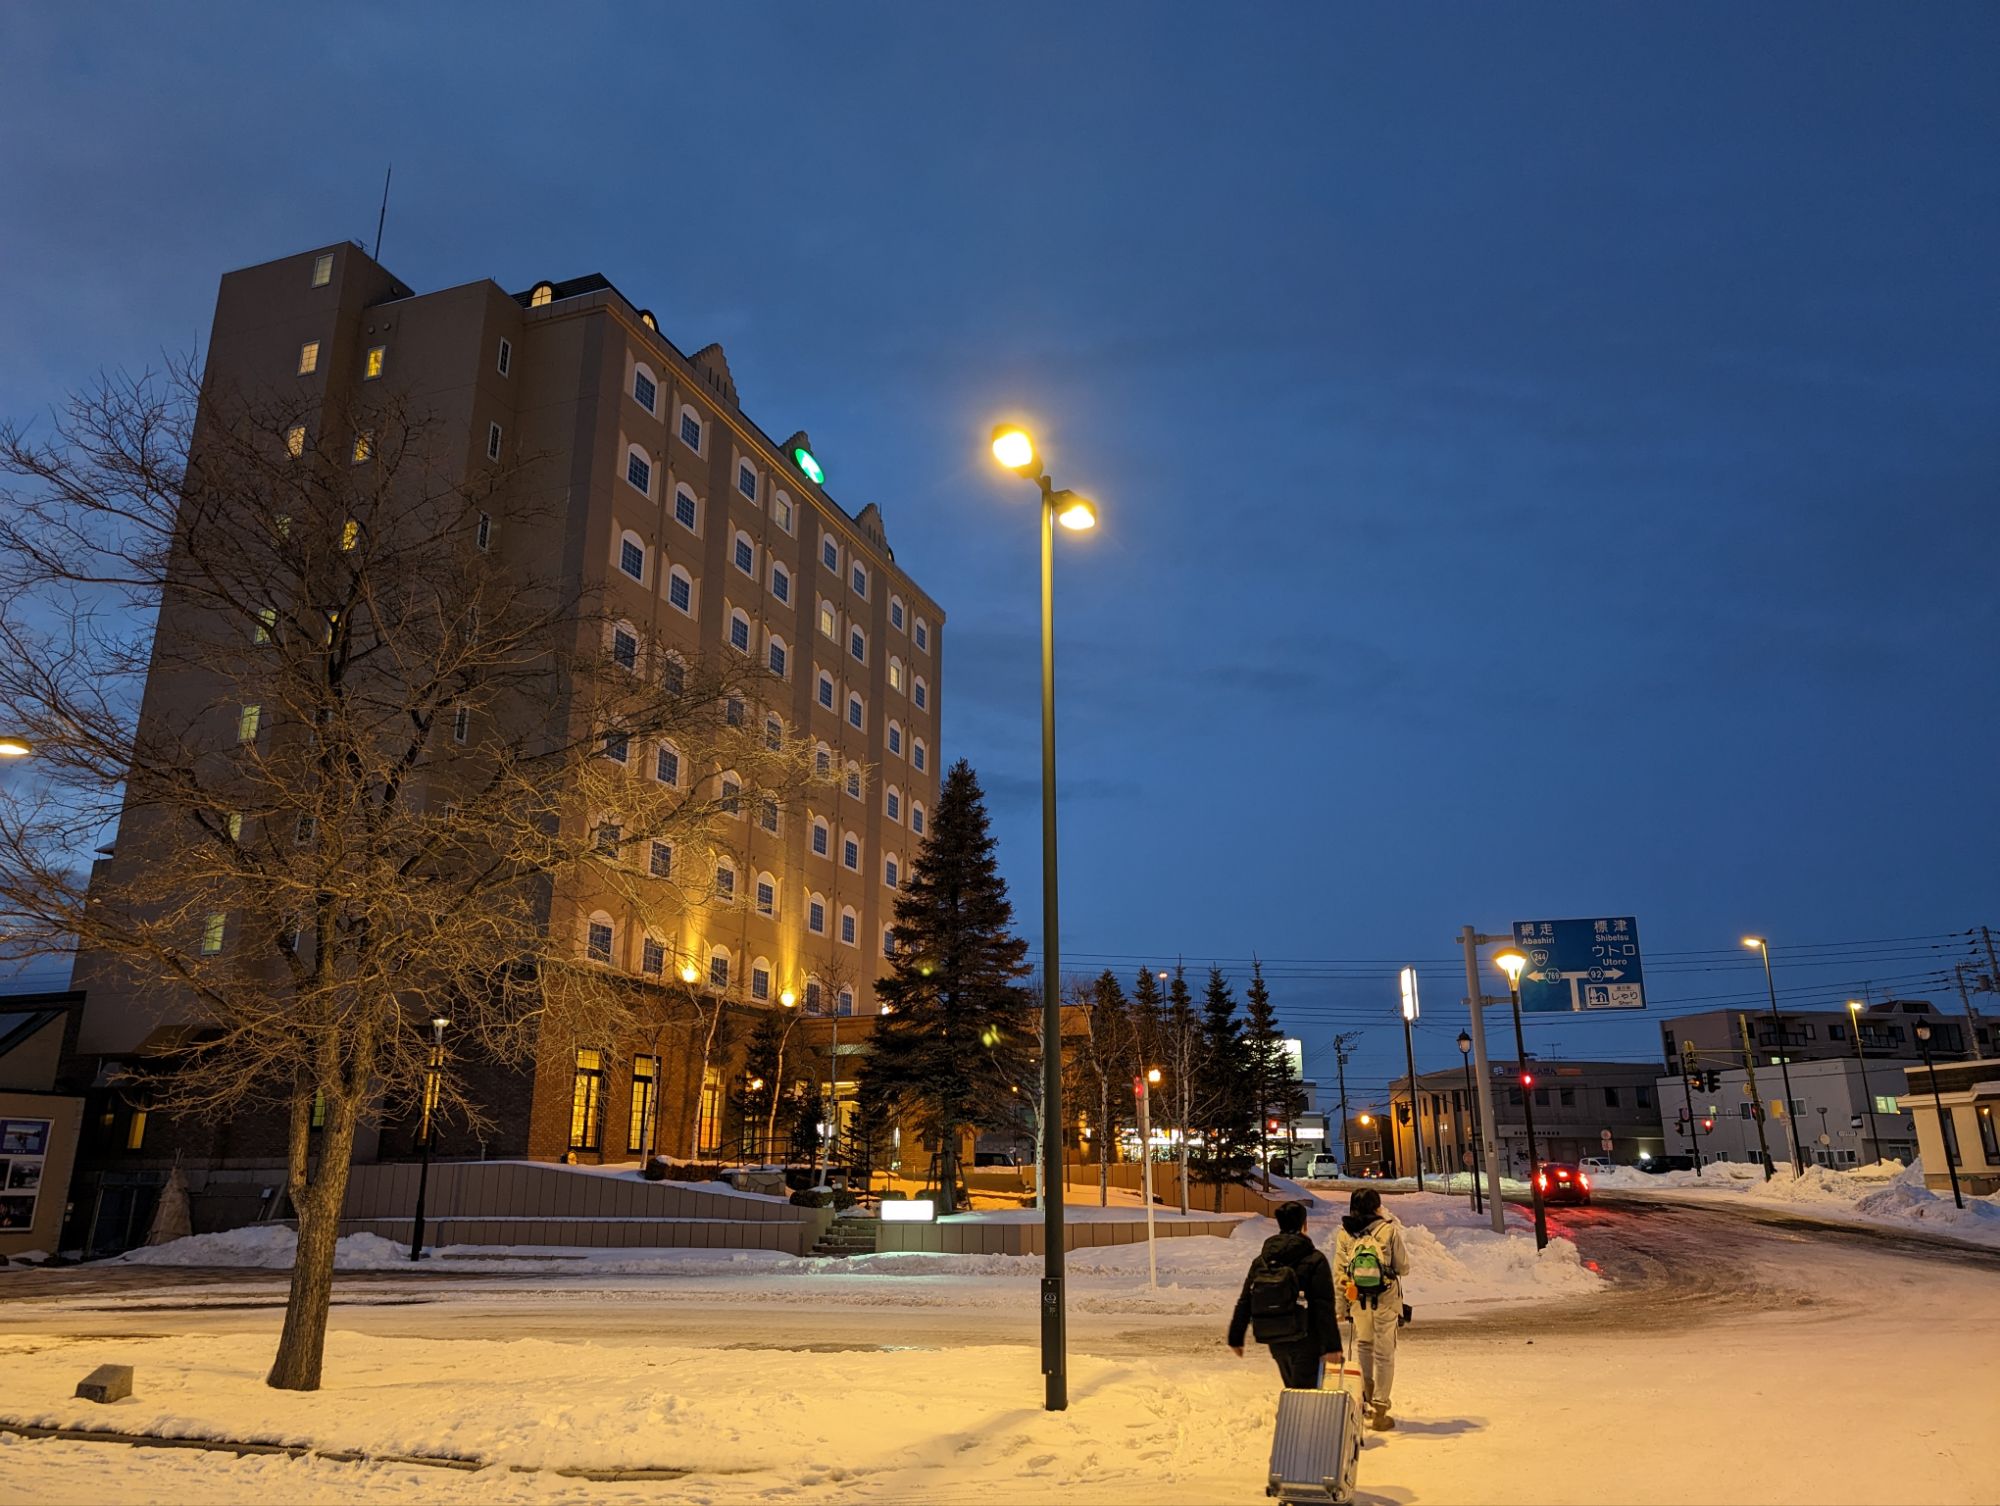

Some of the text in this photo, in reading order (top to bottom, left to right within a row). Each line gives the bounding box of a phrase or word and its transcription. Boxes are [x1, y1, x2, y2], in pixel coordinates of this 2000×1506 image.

[1521, 923, 1553, 936] 網走
[1594, 919, 1627, 933] 標津
[1523, 937, 1555, 945] Abashiri
[1595, 934, 1629, 942] Shibetsu
[1592, 944, 1636, 957] ウトロ
[1602, 958, 1628, 966] Utoro
[1590, 970, 1602, 978] 92
[1611, 991, 1638, 1001] しゃり
